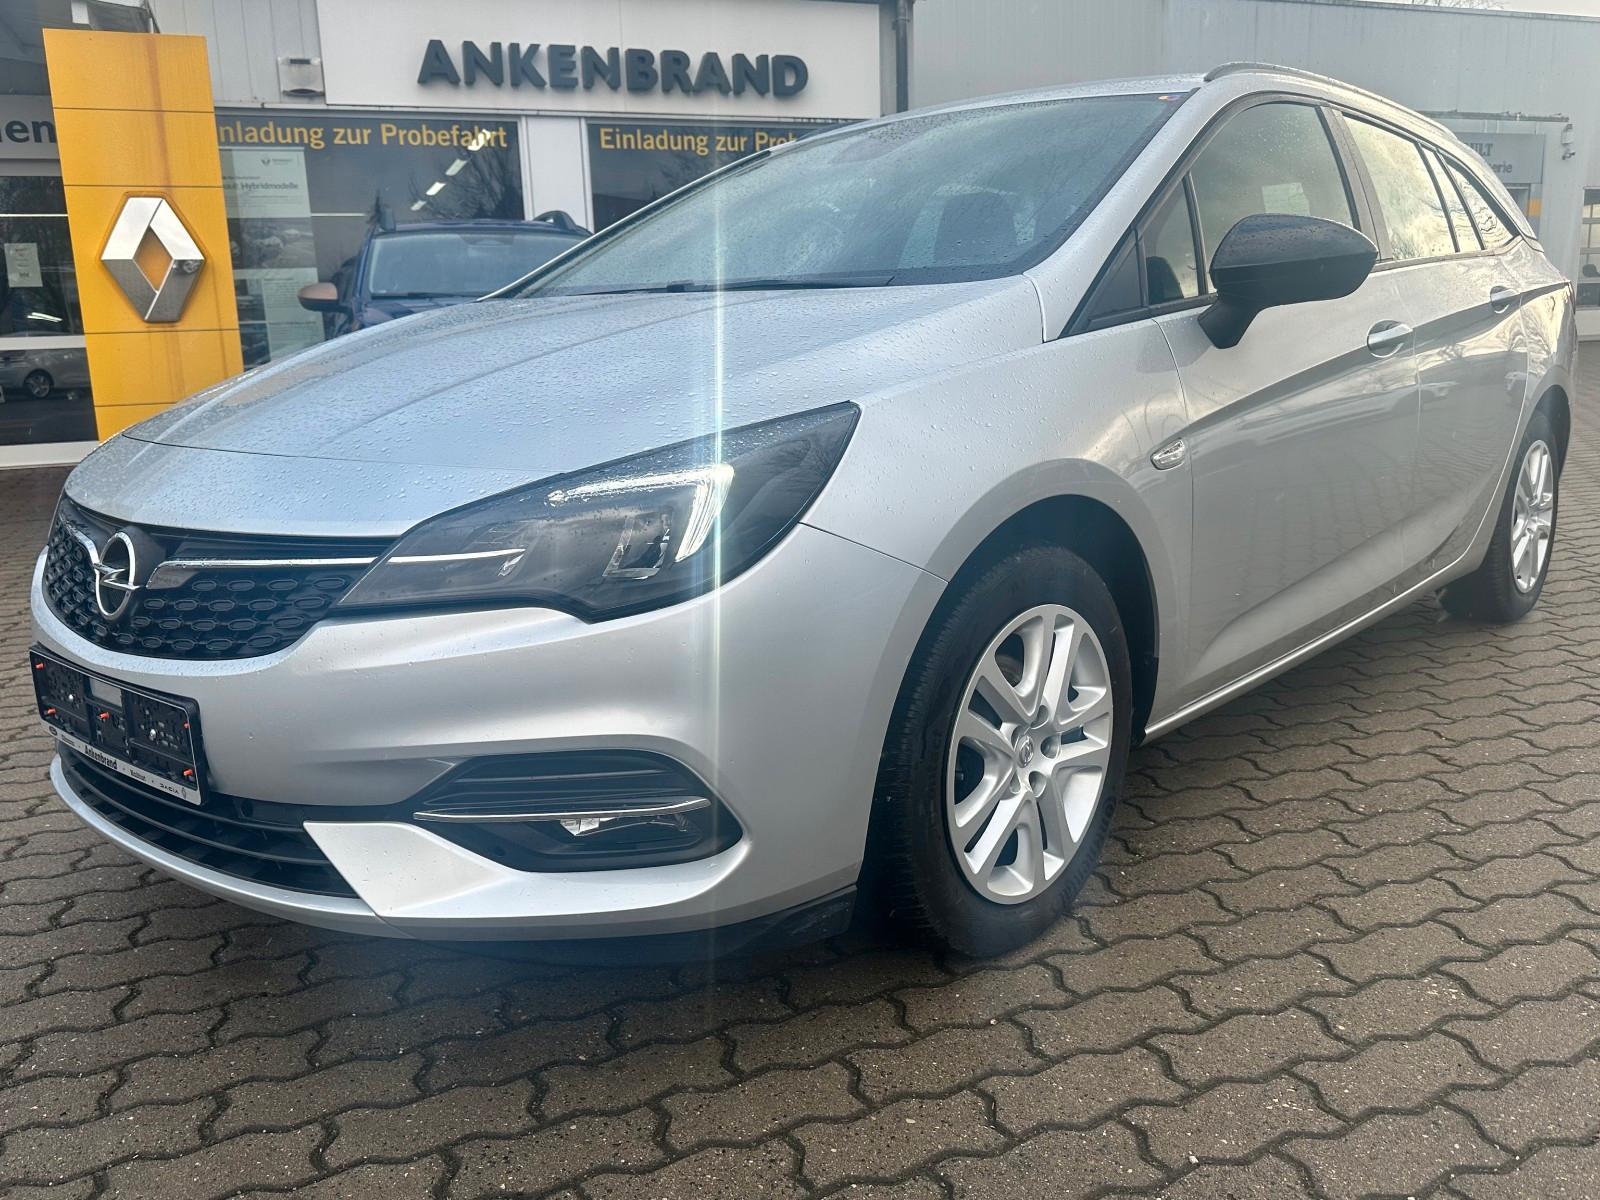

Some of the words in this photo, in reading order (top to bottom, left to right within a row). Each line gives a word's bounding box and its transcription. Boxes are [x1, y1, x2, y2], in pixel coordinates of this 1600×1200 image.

[417, 39, 809, 97] ANKENBRAND
[0, 120, 57, 143] en
[219, 120, 325, 150] nladung
[332, 126, 372, 146] zur
[380, 122, 508, 149] Probefahrt
[599, 127, 709, 156] Einladung
[715, 136, 749, 153] zur
